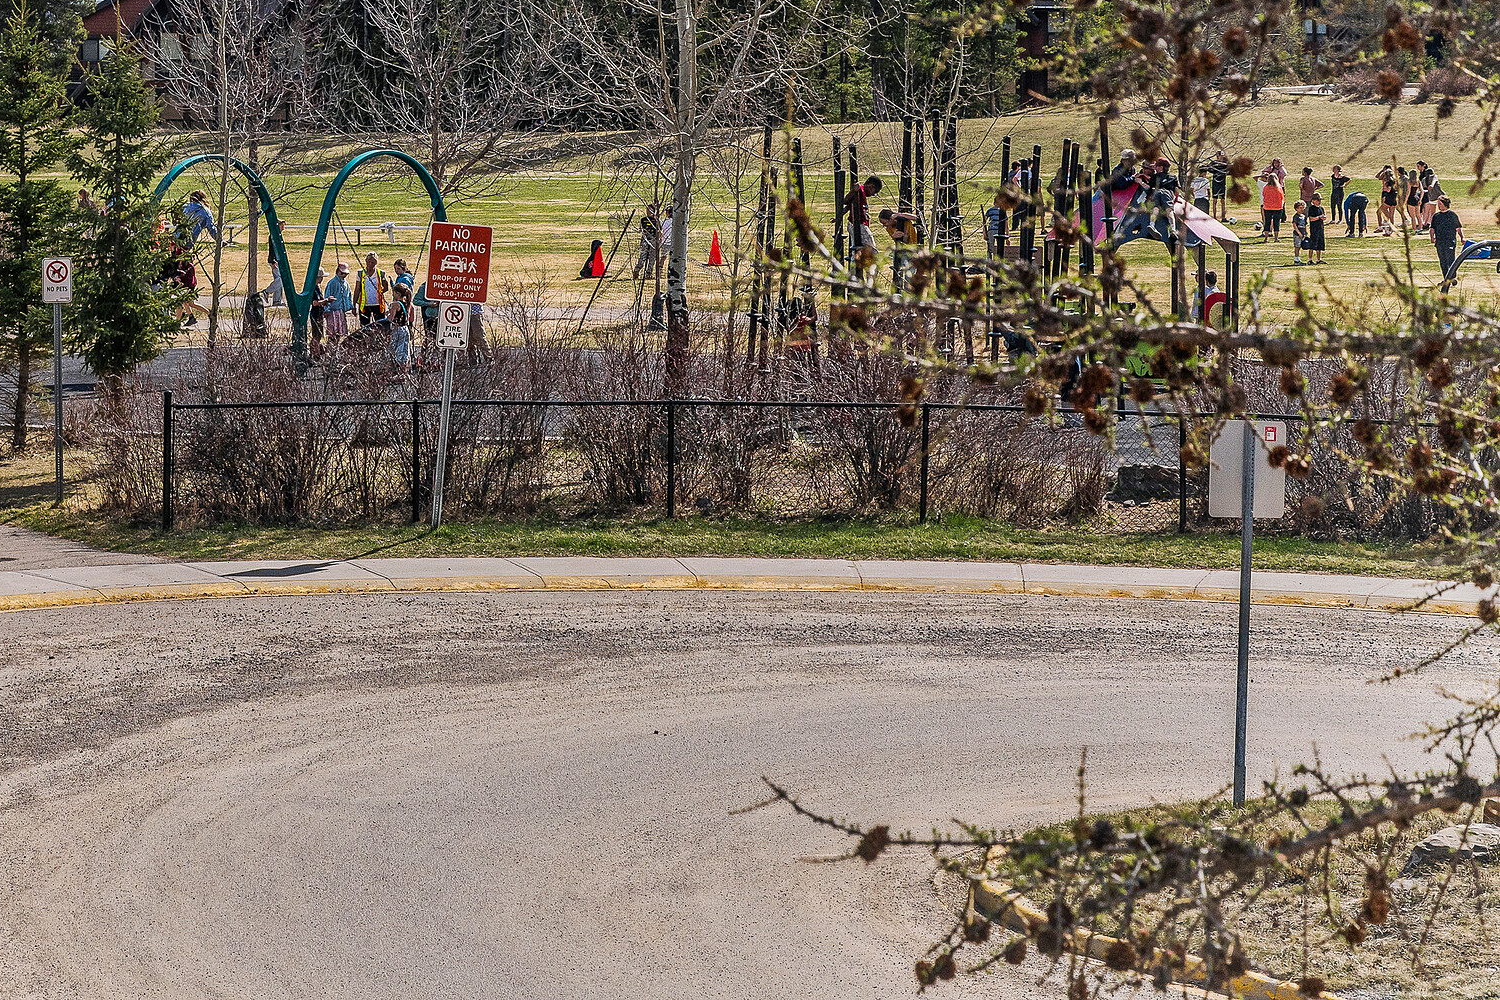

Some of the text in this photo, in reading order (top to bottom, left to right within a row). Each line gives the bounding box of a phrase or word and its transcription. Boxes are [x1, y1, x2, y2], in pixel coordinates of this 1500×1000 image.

[452, 228, 471, 240] NO
[435, 239, 486, 254] PARKING
[432, 274, 466, 283] DROP-OFF
[433, 281, 461, 290] PICK-UP
